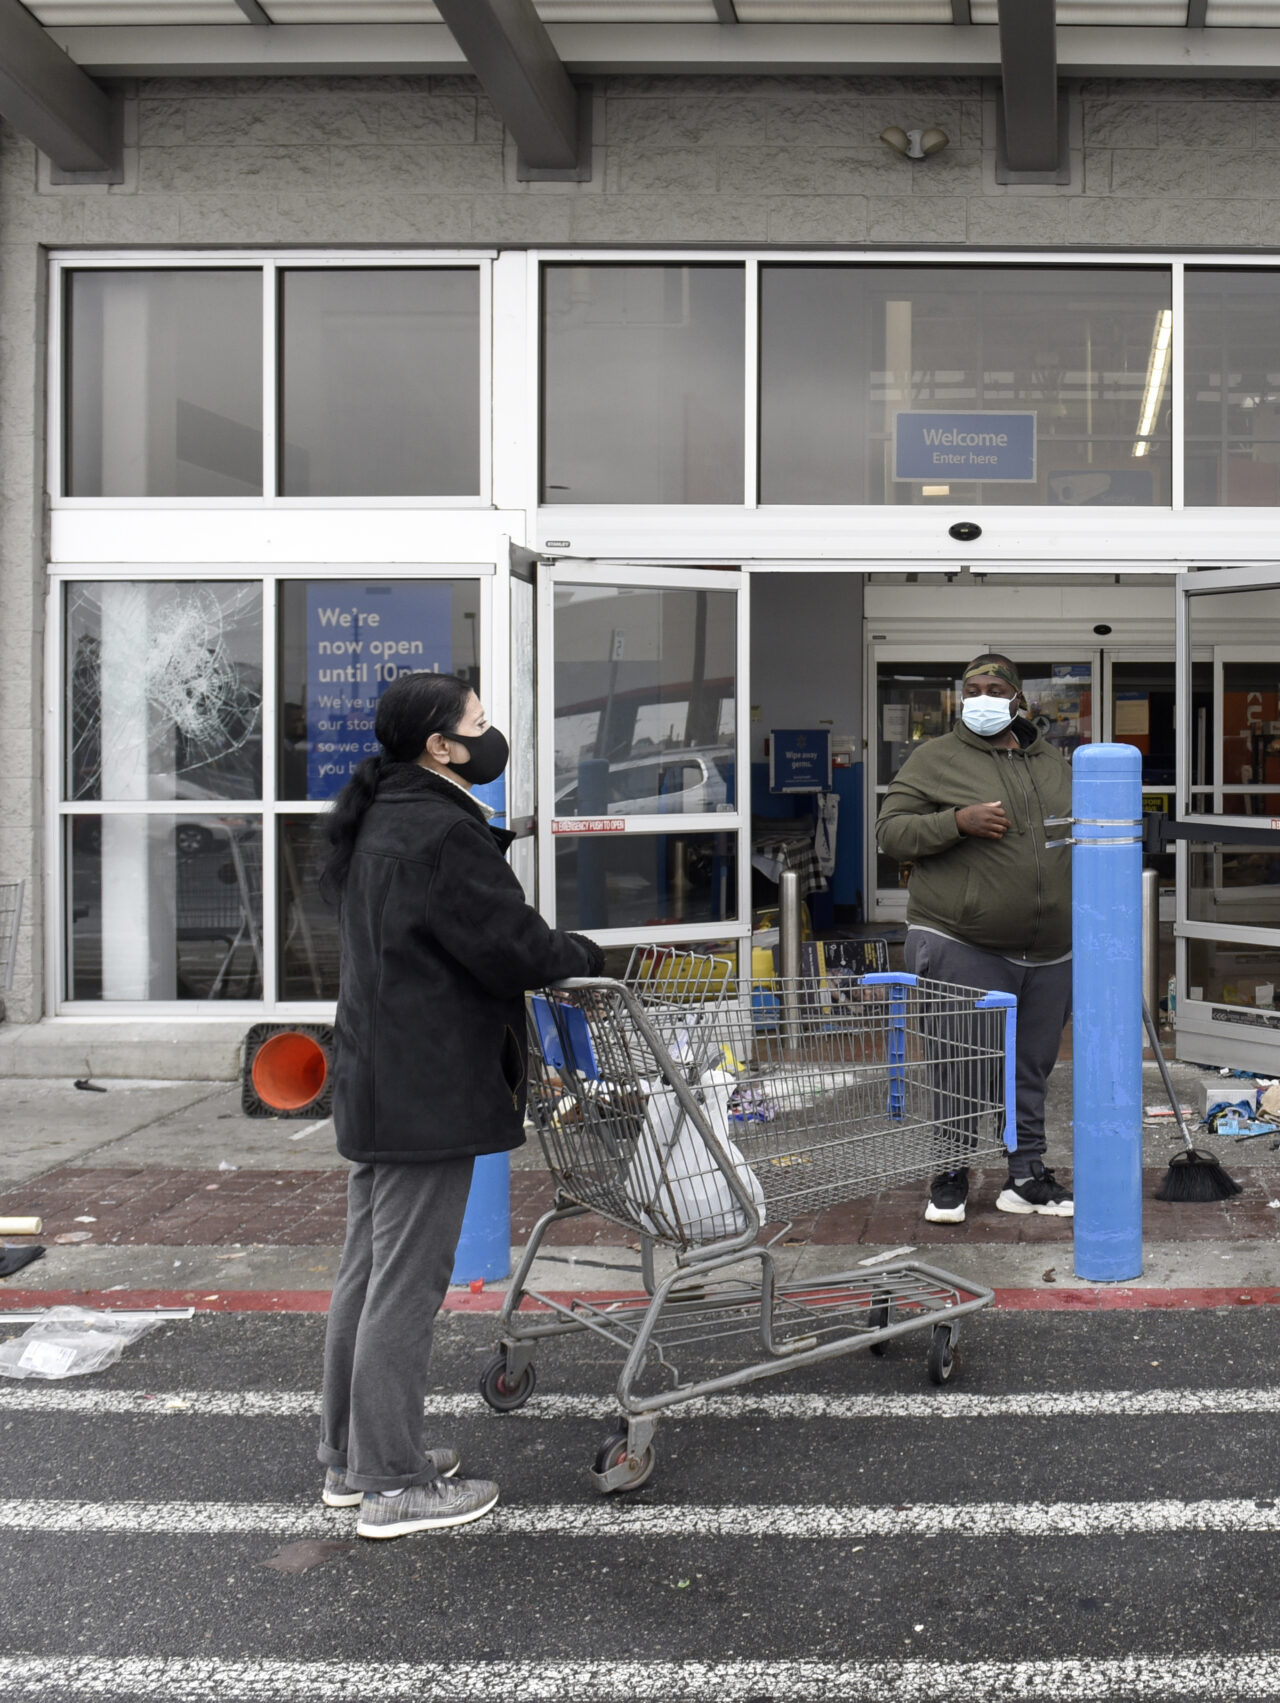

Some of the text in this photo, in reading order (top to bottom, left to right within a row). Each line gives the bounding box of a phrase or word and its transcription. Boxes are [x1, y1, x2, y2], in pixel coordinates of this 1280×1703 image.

[922, 428, 1008, 447] Welcome
[932, 452, 998, 465] Enter here
[318, 640, 423, 660] now open
[319, 663, 368, 682] until
[318, 721, 343, 731] our
[318, 743, 335, 753] so
[340, 743, 359, 753] we
[318, 764, 344, 778] you
[559, 821, 589, 832] EMERGENCY
[590, 820, 603, 831] PUSH
[604, 820, 610, 831] TO
[611, 819, 625, 830] OPEN
